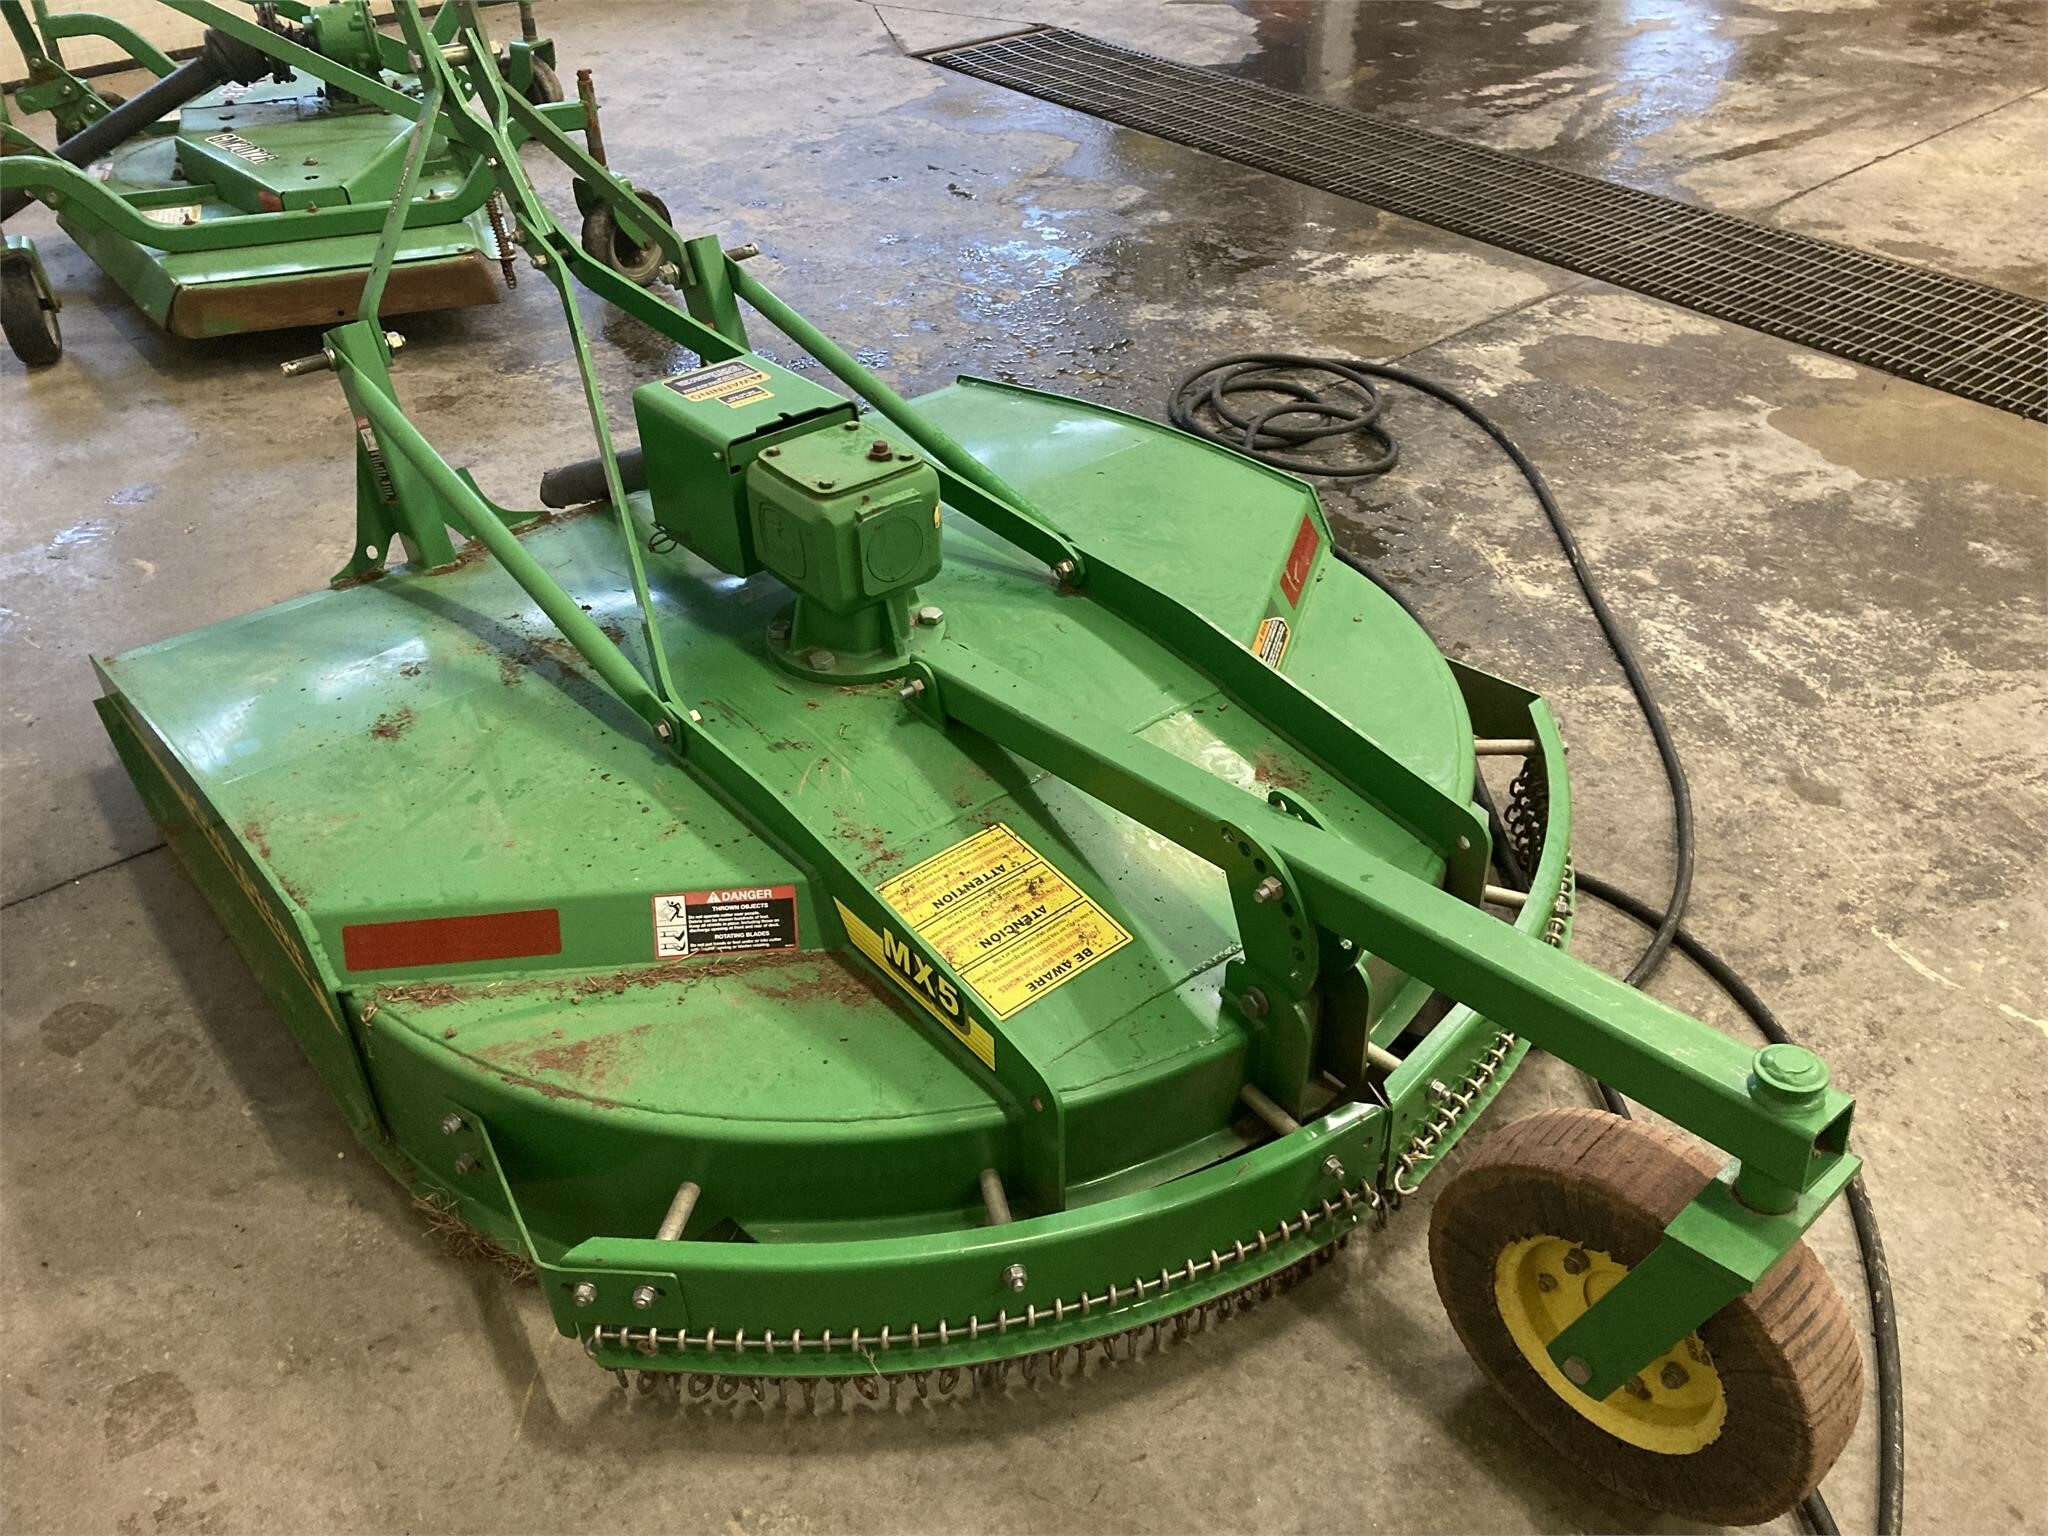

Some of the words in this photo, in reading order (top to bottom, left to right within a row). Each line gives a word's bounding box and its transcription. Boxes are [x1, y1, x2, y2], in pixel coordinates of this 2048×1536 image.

[721, 889, 773, 902] DANGER
[930, 863, 1008, 909] ATTENTION
[712, 904, 739, 912] THROWN
[740, 901, 768, 909] OBJECTS
[714, 932, 744, 940] ROTATING
[977, 904, 1051, 950] ATENCIÓN
[1072, 946, 1094, 962] BE
[883, 927, 959, 1016] MX5
[1024, 959, 1074, 992] AWARE
